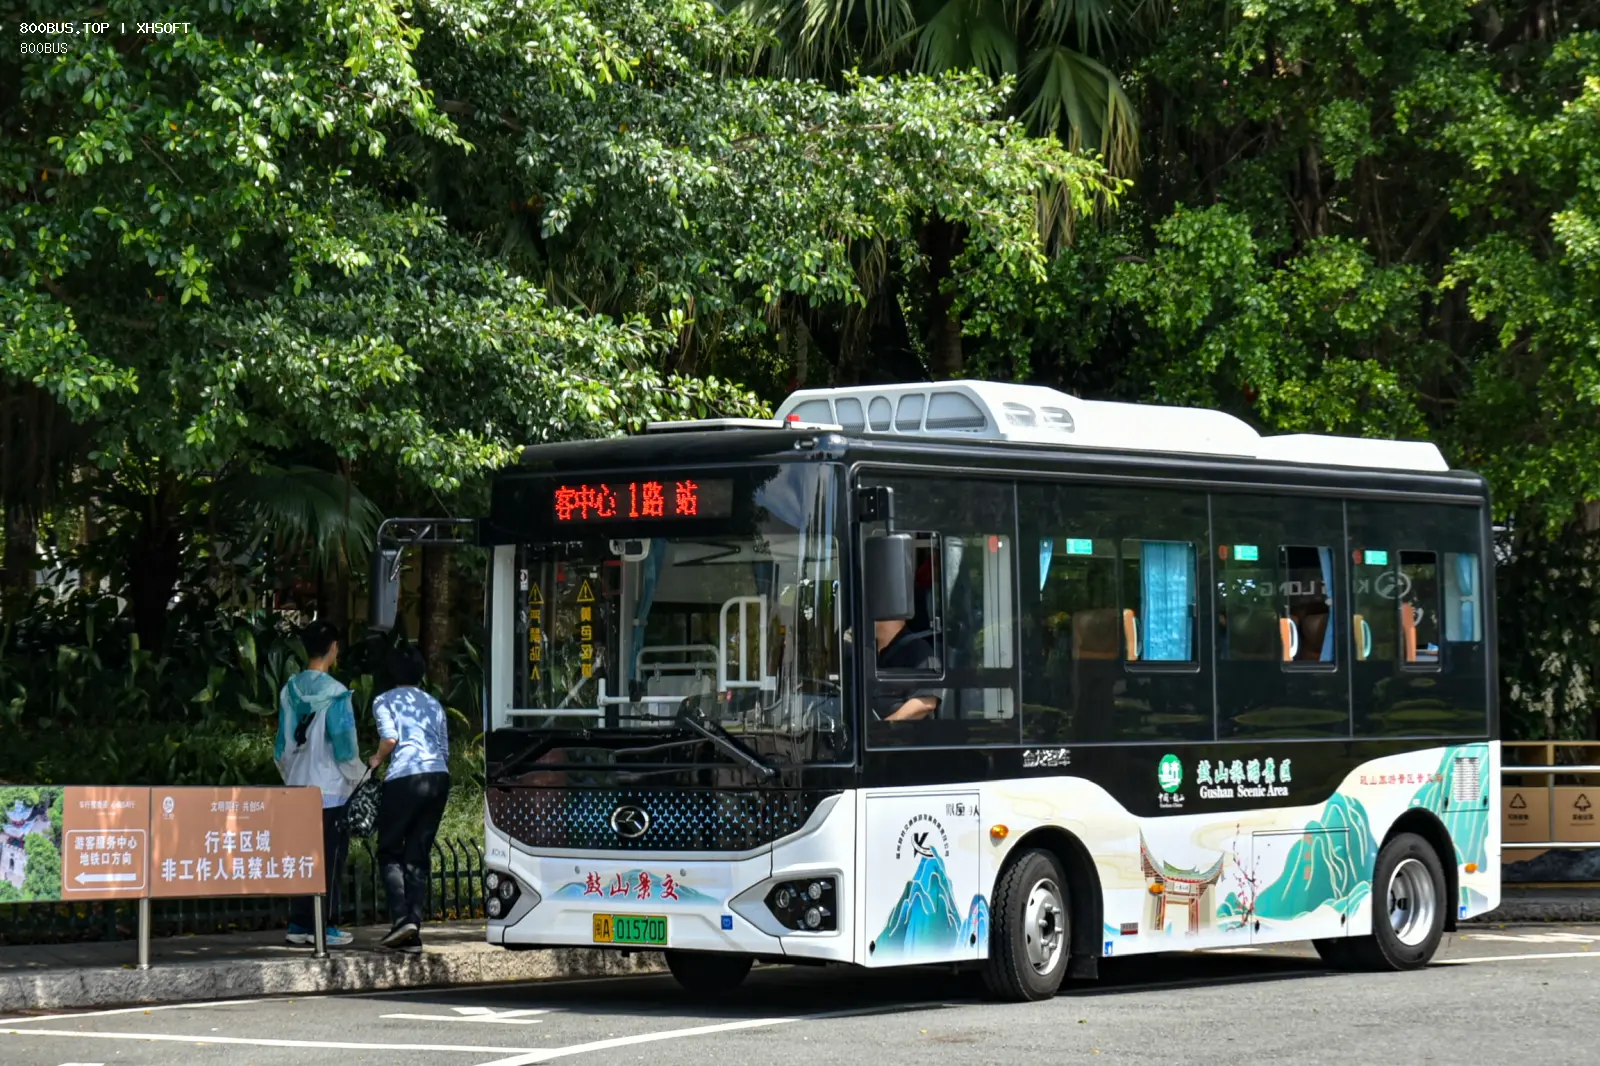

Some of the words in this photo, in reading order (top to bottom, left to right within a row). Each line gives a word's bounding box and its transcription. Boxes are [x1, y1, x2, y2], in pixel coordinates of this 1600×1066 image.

[554, 483, 617, 520] 客中心
[675, 479, 698, 515] 站
[1199, 785, 1234, 799] Gushan
[1237, 784, 1267, 798] Scenic
[1267, 783, 1289, 797] Area
[74, 835, 138, 850] 游客服务中心
[204, 830, 271, 854] 行车区域
[80, 851, 132, 866] 地铁口方向
[161, 855, 315, 882] 非工作人员禁止穿行
